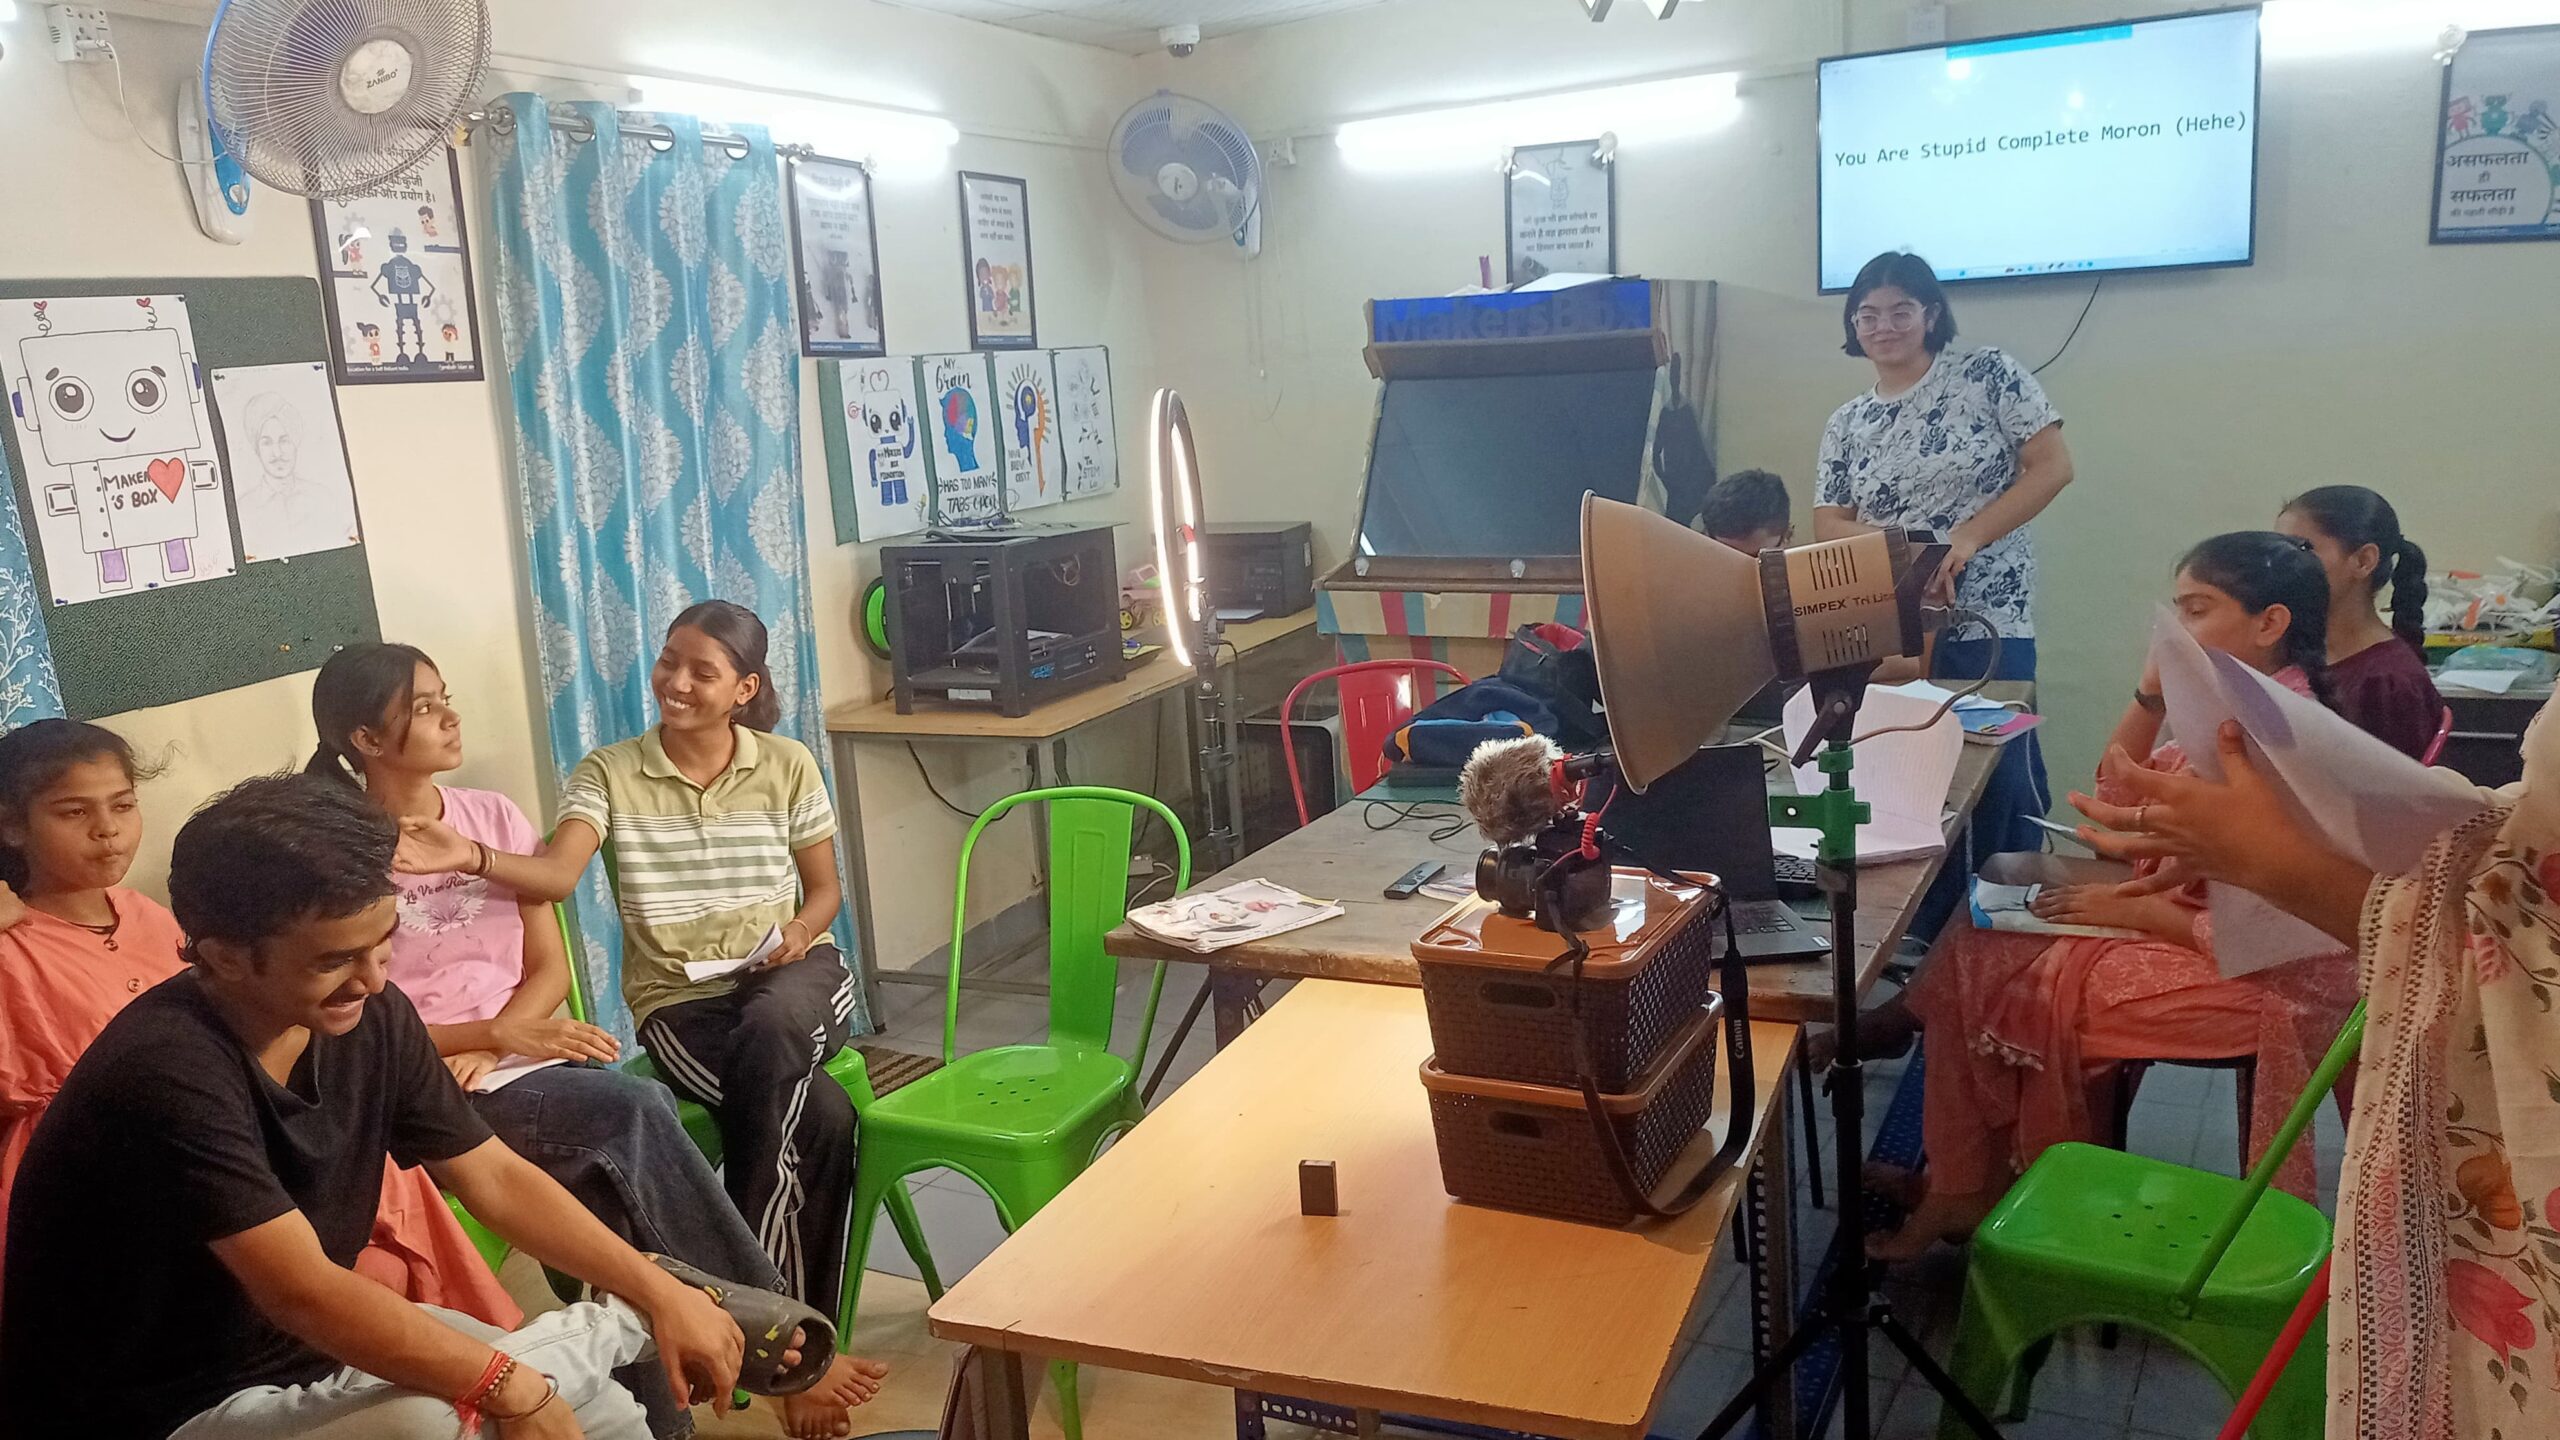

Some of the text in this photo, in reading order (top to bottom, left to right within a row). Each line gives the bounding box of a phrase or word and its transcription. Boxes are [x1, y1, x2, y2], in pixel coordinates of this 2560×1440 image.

[366, 71, 397, 89] ZANIBO
[1835, 110, 2247, 167] You Are Stupid Complete Moron (Hehe)
[2446, 151, 2529, 168] असफलता
[2450, 187, 2517, 203] सफलता
[943, 357, 956, 370] MY
[935, 364, 972, 394] brain
[943, 477, 960, 493] HAS
[131, 488, 159, 509] BOX
[1793, 599, 1848, 617] SIMPEX
[1733, 1018, 1745, 1060] Canon
